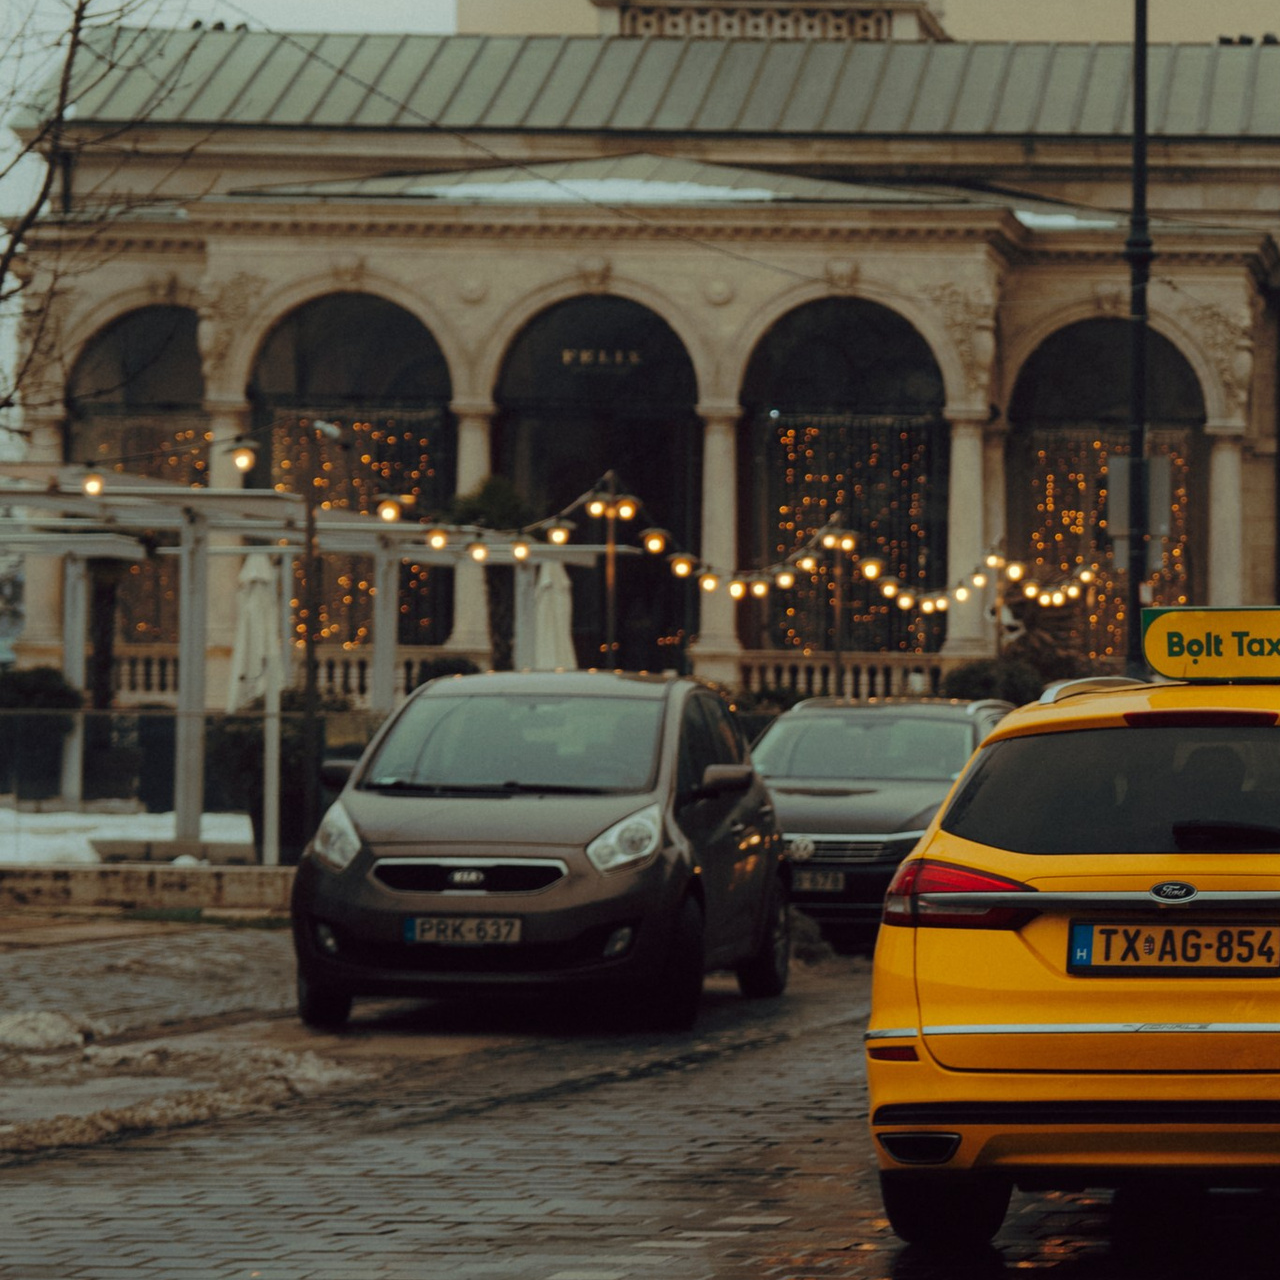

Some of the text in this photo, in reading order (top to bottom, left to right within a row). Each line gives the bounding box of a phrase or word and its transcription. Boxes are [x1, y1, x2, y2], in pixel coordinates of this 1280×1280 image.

[1167, 631, 1223, 665] Bolt
[452, 870, 485, 883] KIA
[1160, 885, 1187, 897] Ford
[419, 917, 515, 942] PRK-637
[1077, 948, 1087, 959] H
[1158, 929, 1275, 963] AG-854
